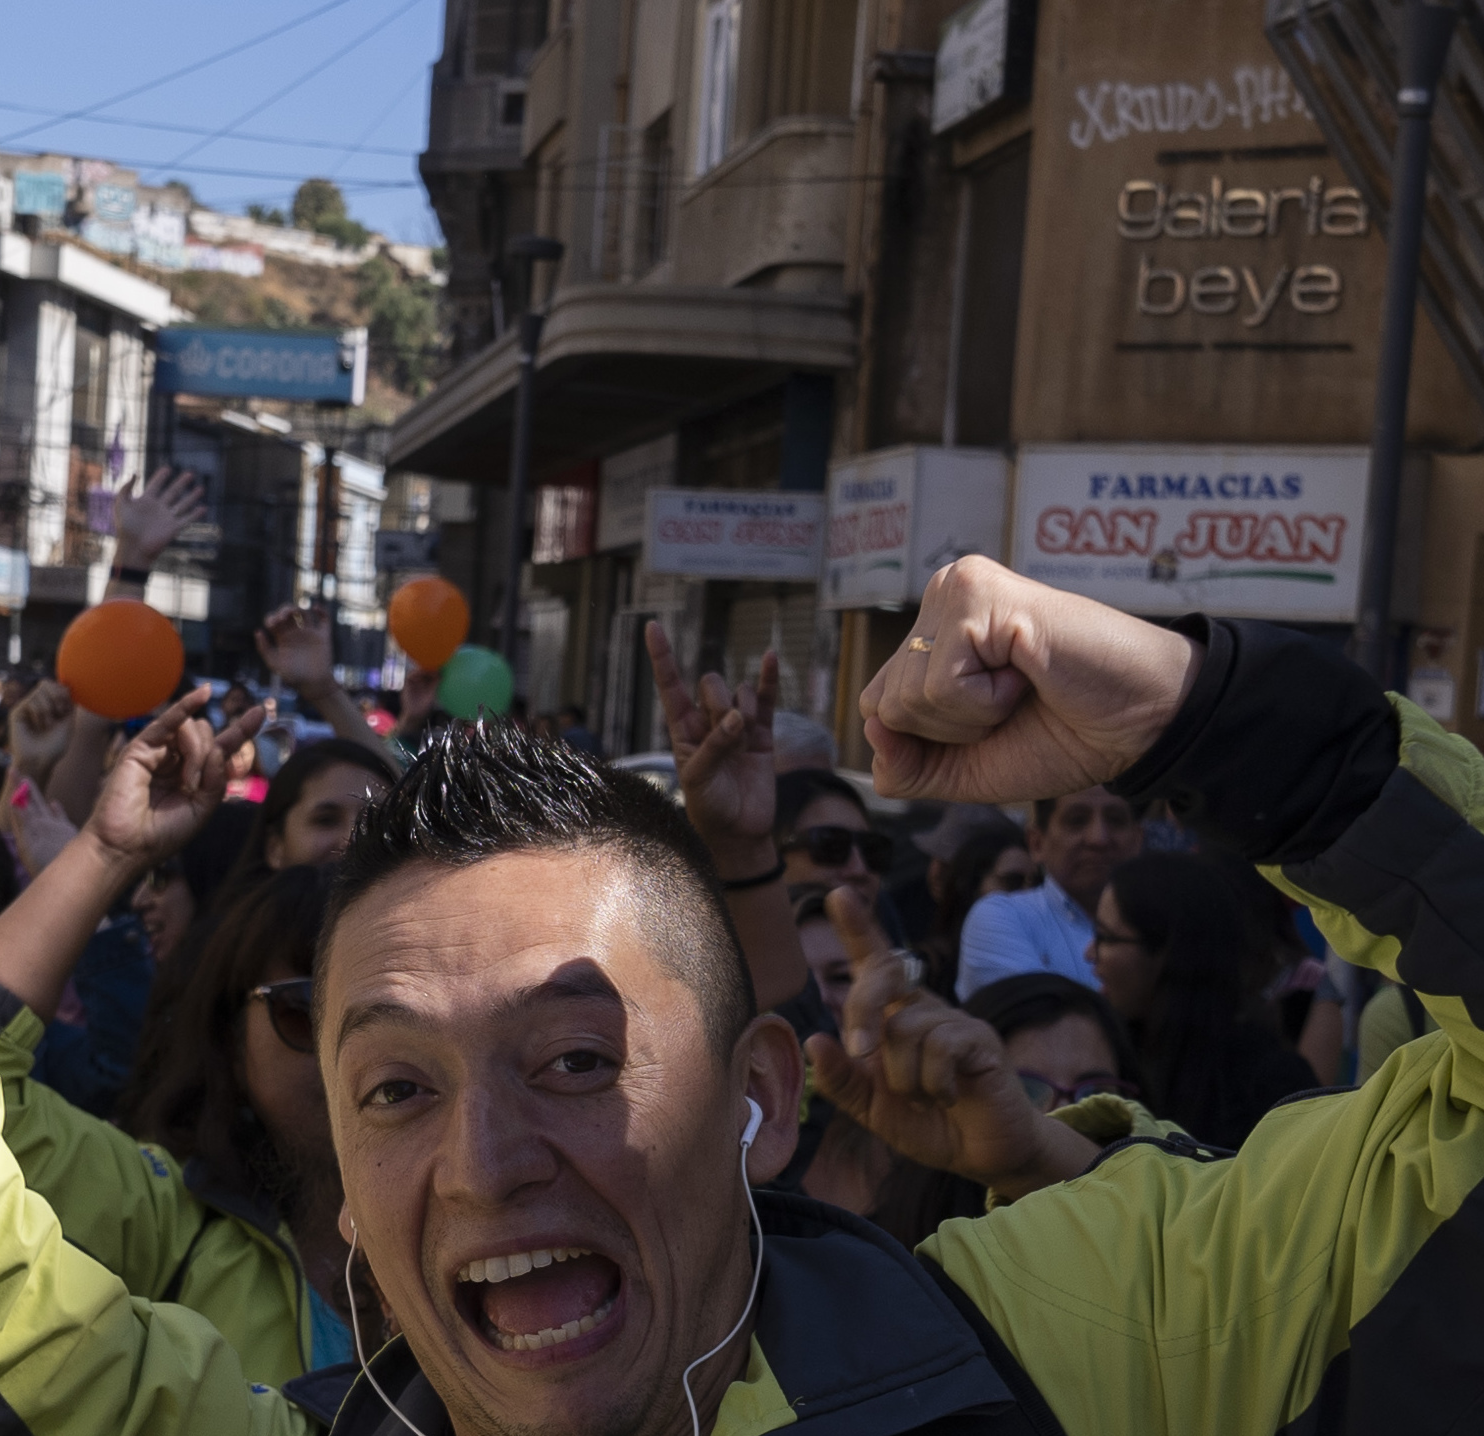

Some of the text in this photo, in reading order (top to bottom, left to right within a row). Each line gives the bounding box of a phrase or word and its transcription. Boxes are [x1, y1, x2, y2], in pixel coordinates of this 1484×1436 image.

[1118, 177, 1369, 240] galeria
[1136, 251, 1343, 328] beye
[1088, 473, 1303, 501] FARMACIAS
[1036, 506, 1348, 565] SAN JUAN
